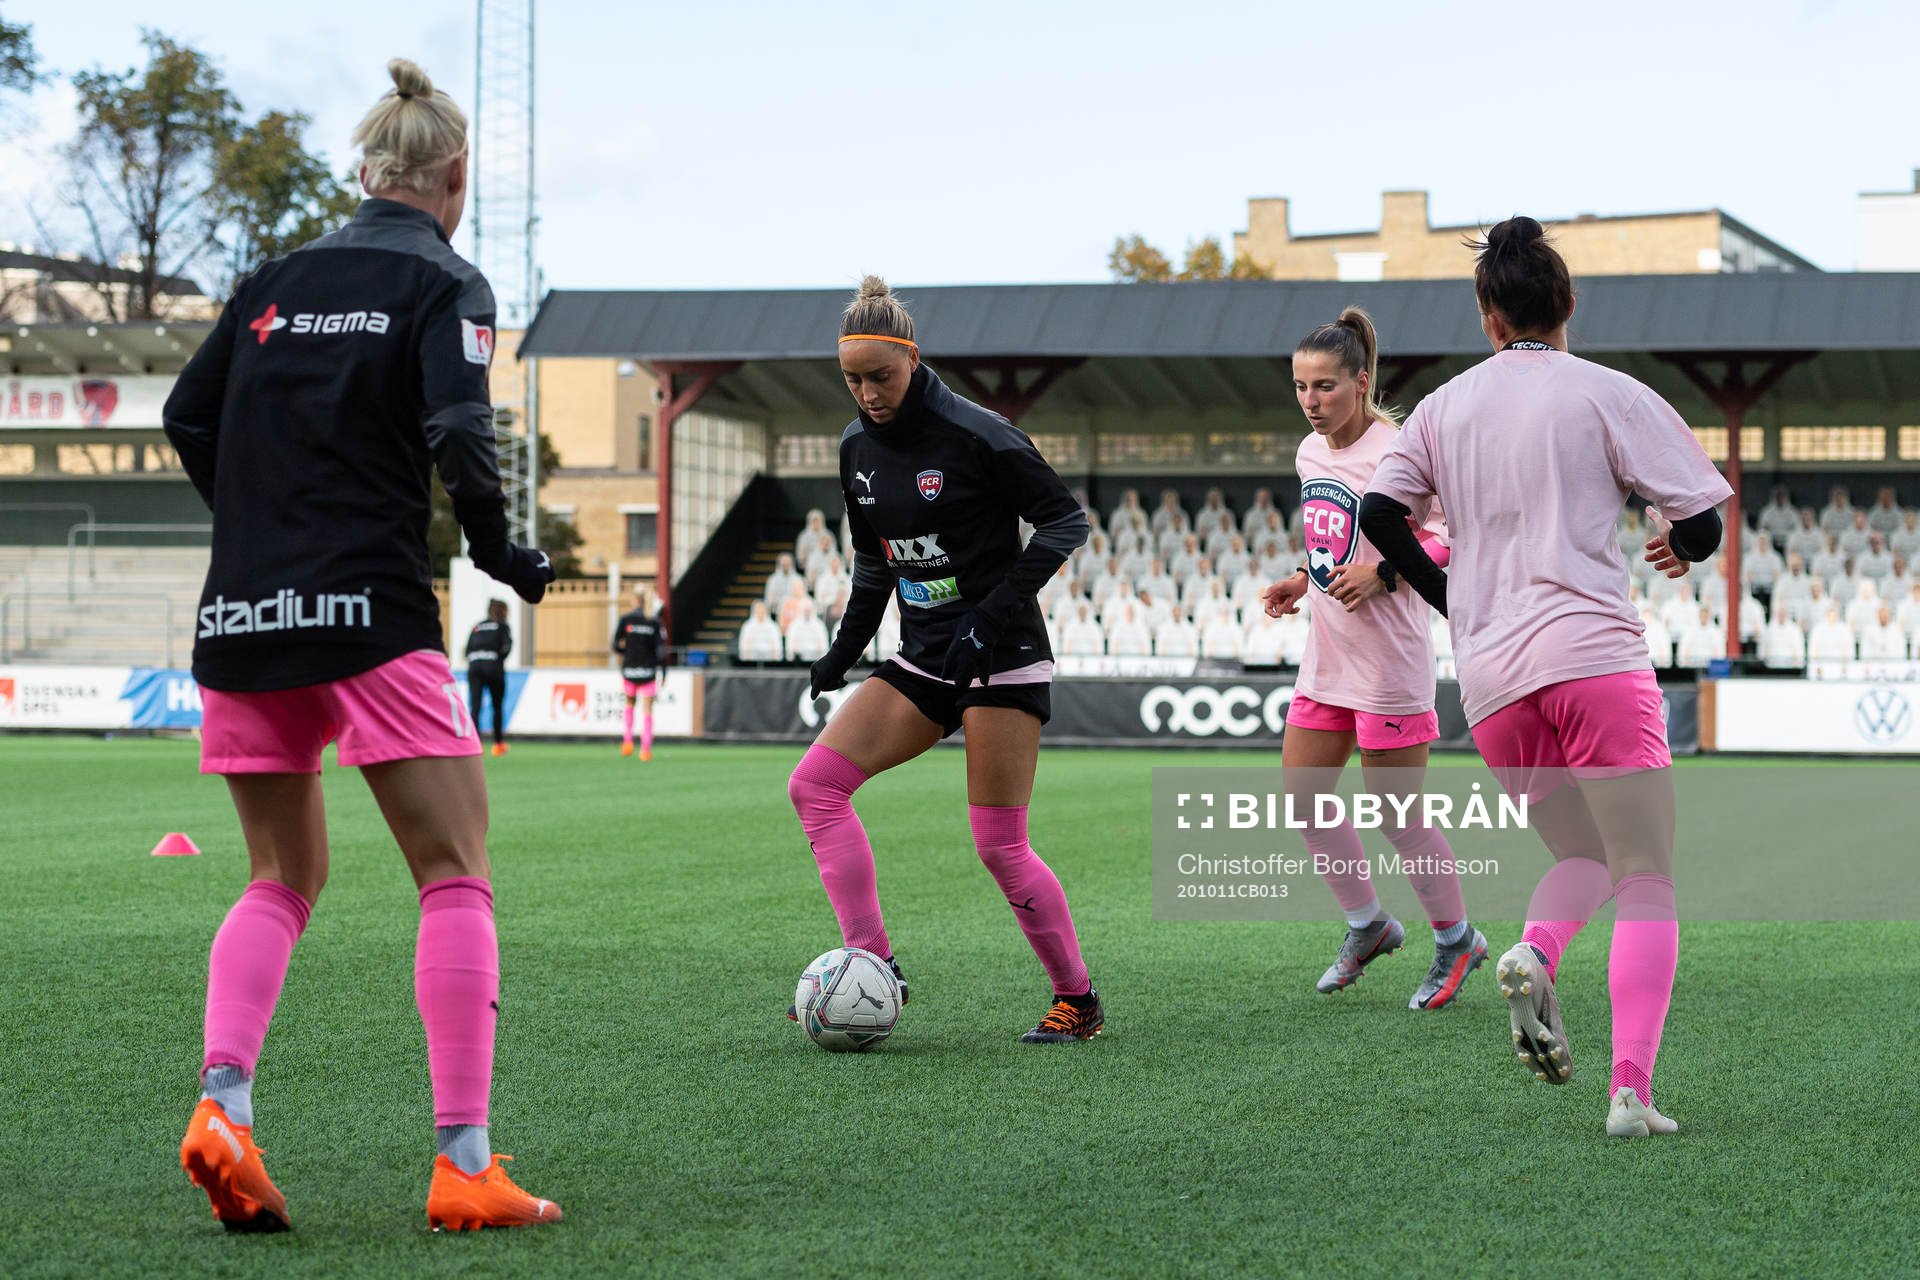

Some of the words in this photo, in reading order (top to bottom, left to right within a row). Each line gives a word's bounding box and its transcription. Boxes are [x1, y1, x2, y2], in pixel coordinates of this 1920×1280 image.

[0, 382, 64, 418] ÅRD
[921, 477, 939, 486] FCR
[1303, 506, 1345, 539] FCR
[902, 582, 924, 599] MKB
